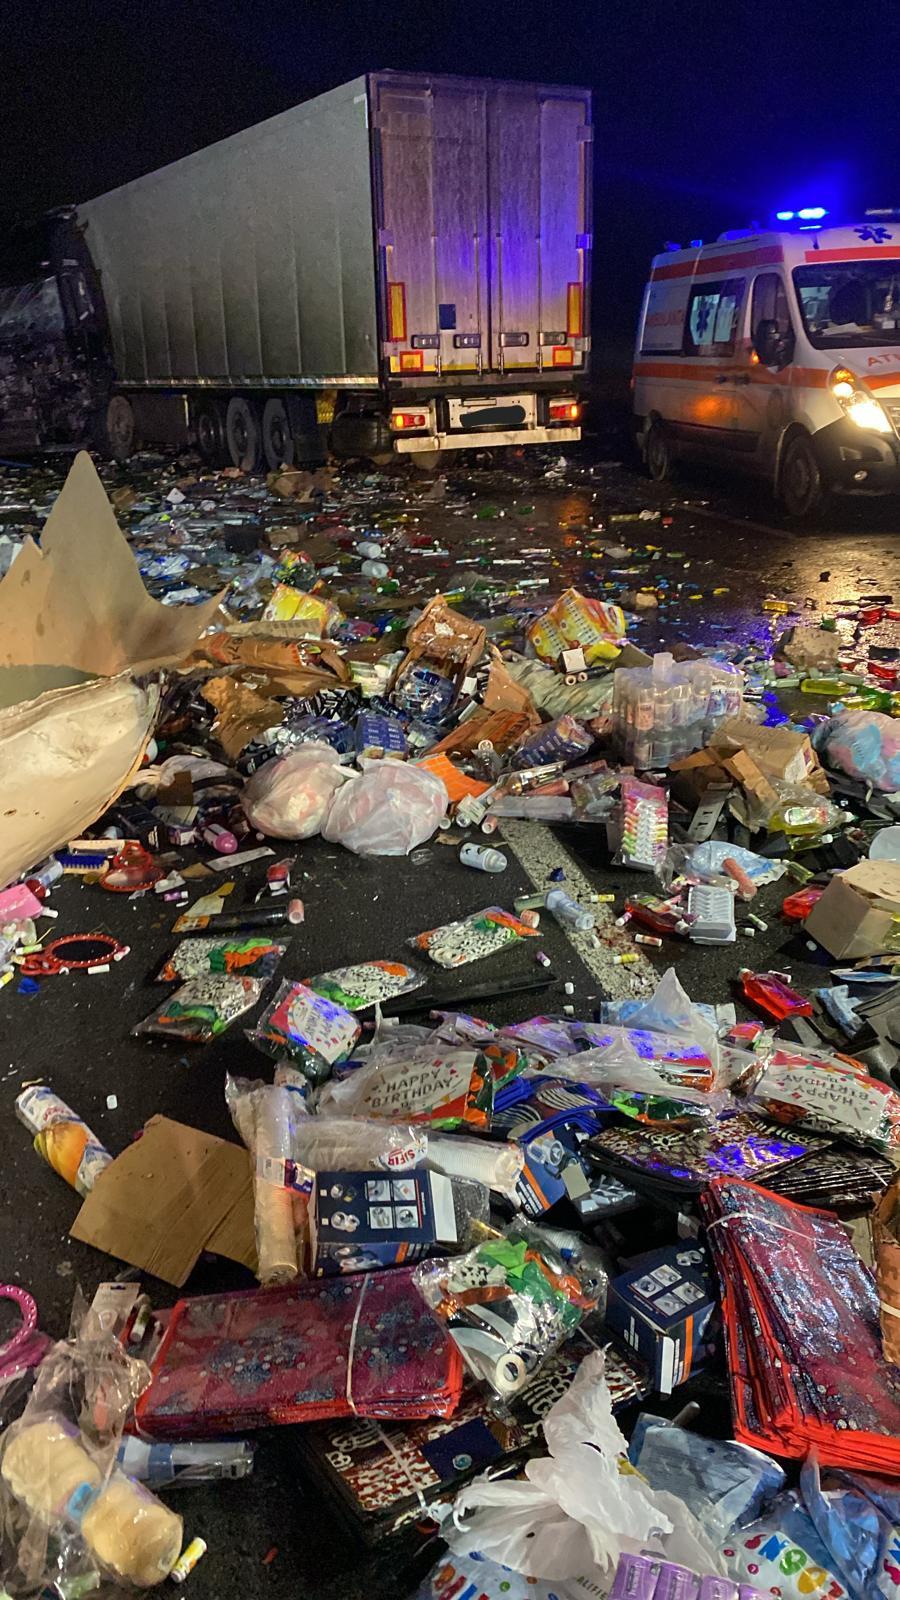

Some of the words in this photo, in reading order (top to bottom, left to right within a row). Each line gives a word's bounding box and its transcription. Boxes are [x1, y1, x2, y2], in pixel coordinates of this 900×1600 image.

[371, 1077, 453, 1108] BIRTHDAY
[387, 1068, 440, 1093] HAPPY
[783, 1074, 868, 1100] BIRTHDAY
[794, 1084, 853, 1105] HAPPY
